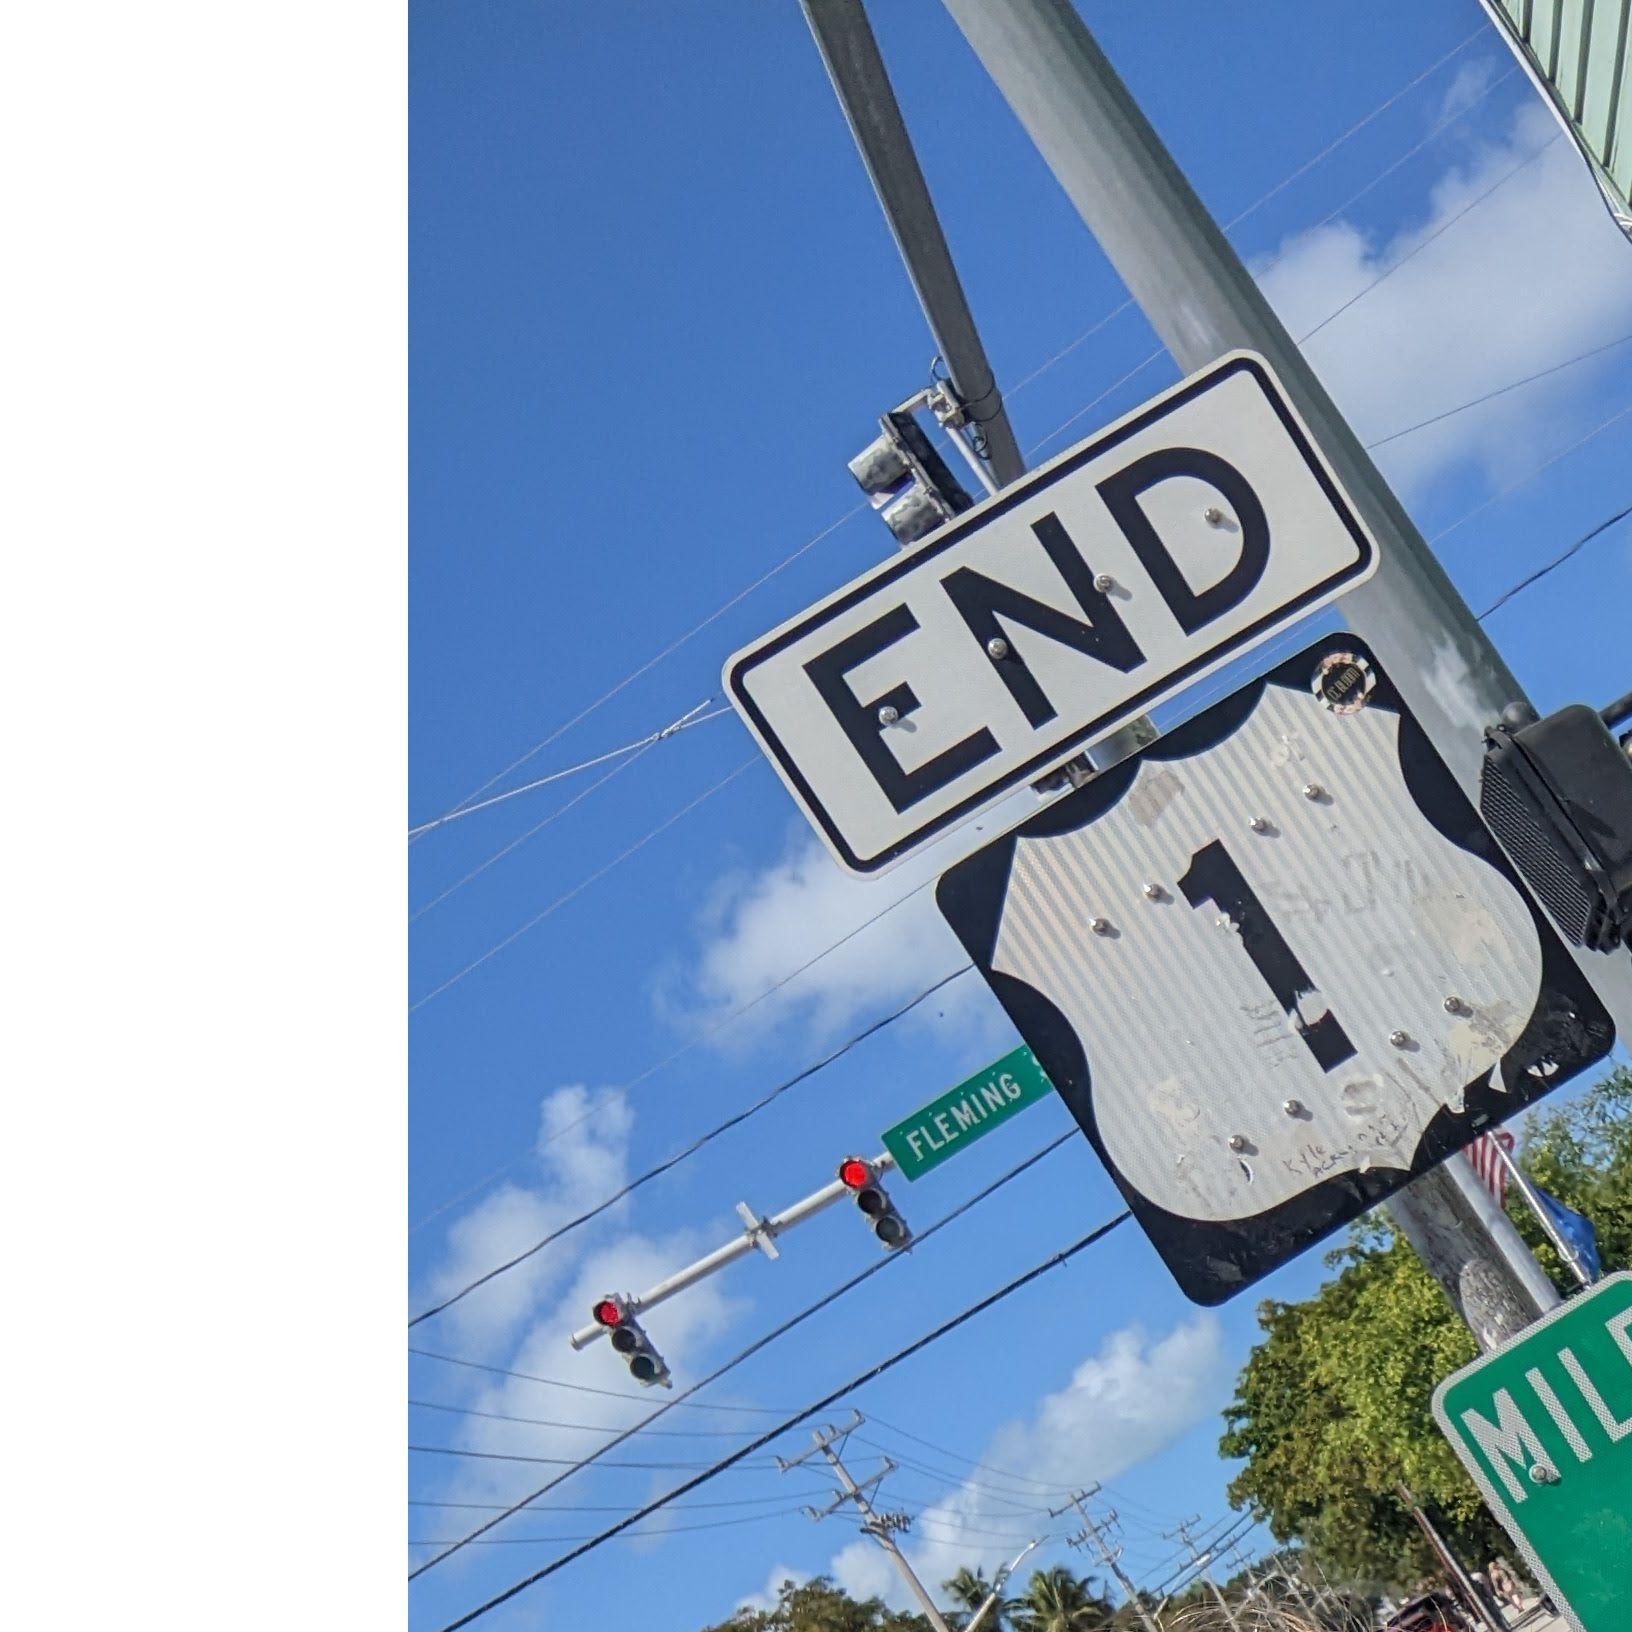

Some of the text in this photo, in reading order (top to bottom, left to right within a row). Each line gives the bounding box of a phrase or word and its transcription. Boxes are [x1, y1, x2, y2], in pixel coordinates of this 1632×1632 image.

[802, 447, 1271, 815] END
[1177, 838, 1358, 1073] 1
[906, 1073, 1021, 1162] FLEMING
